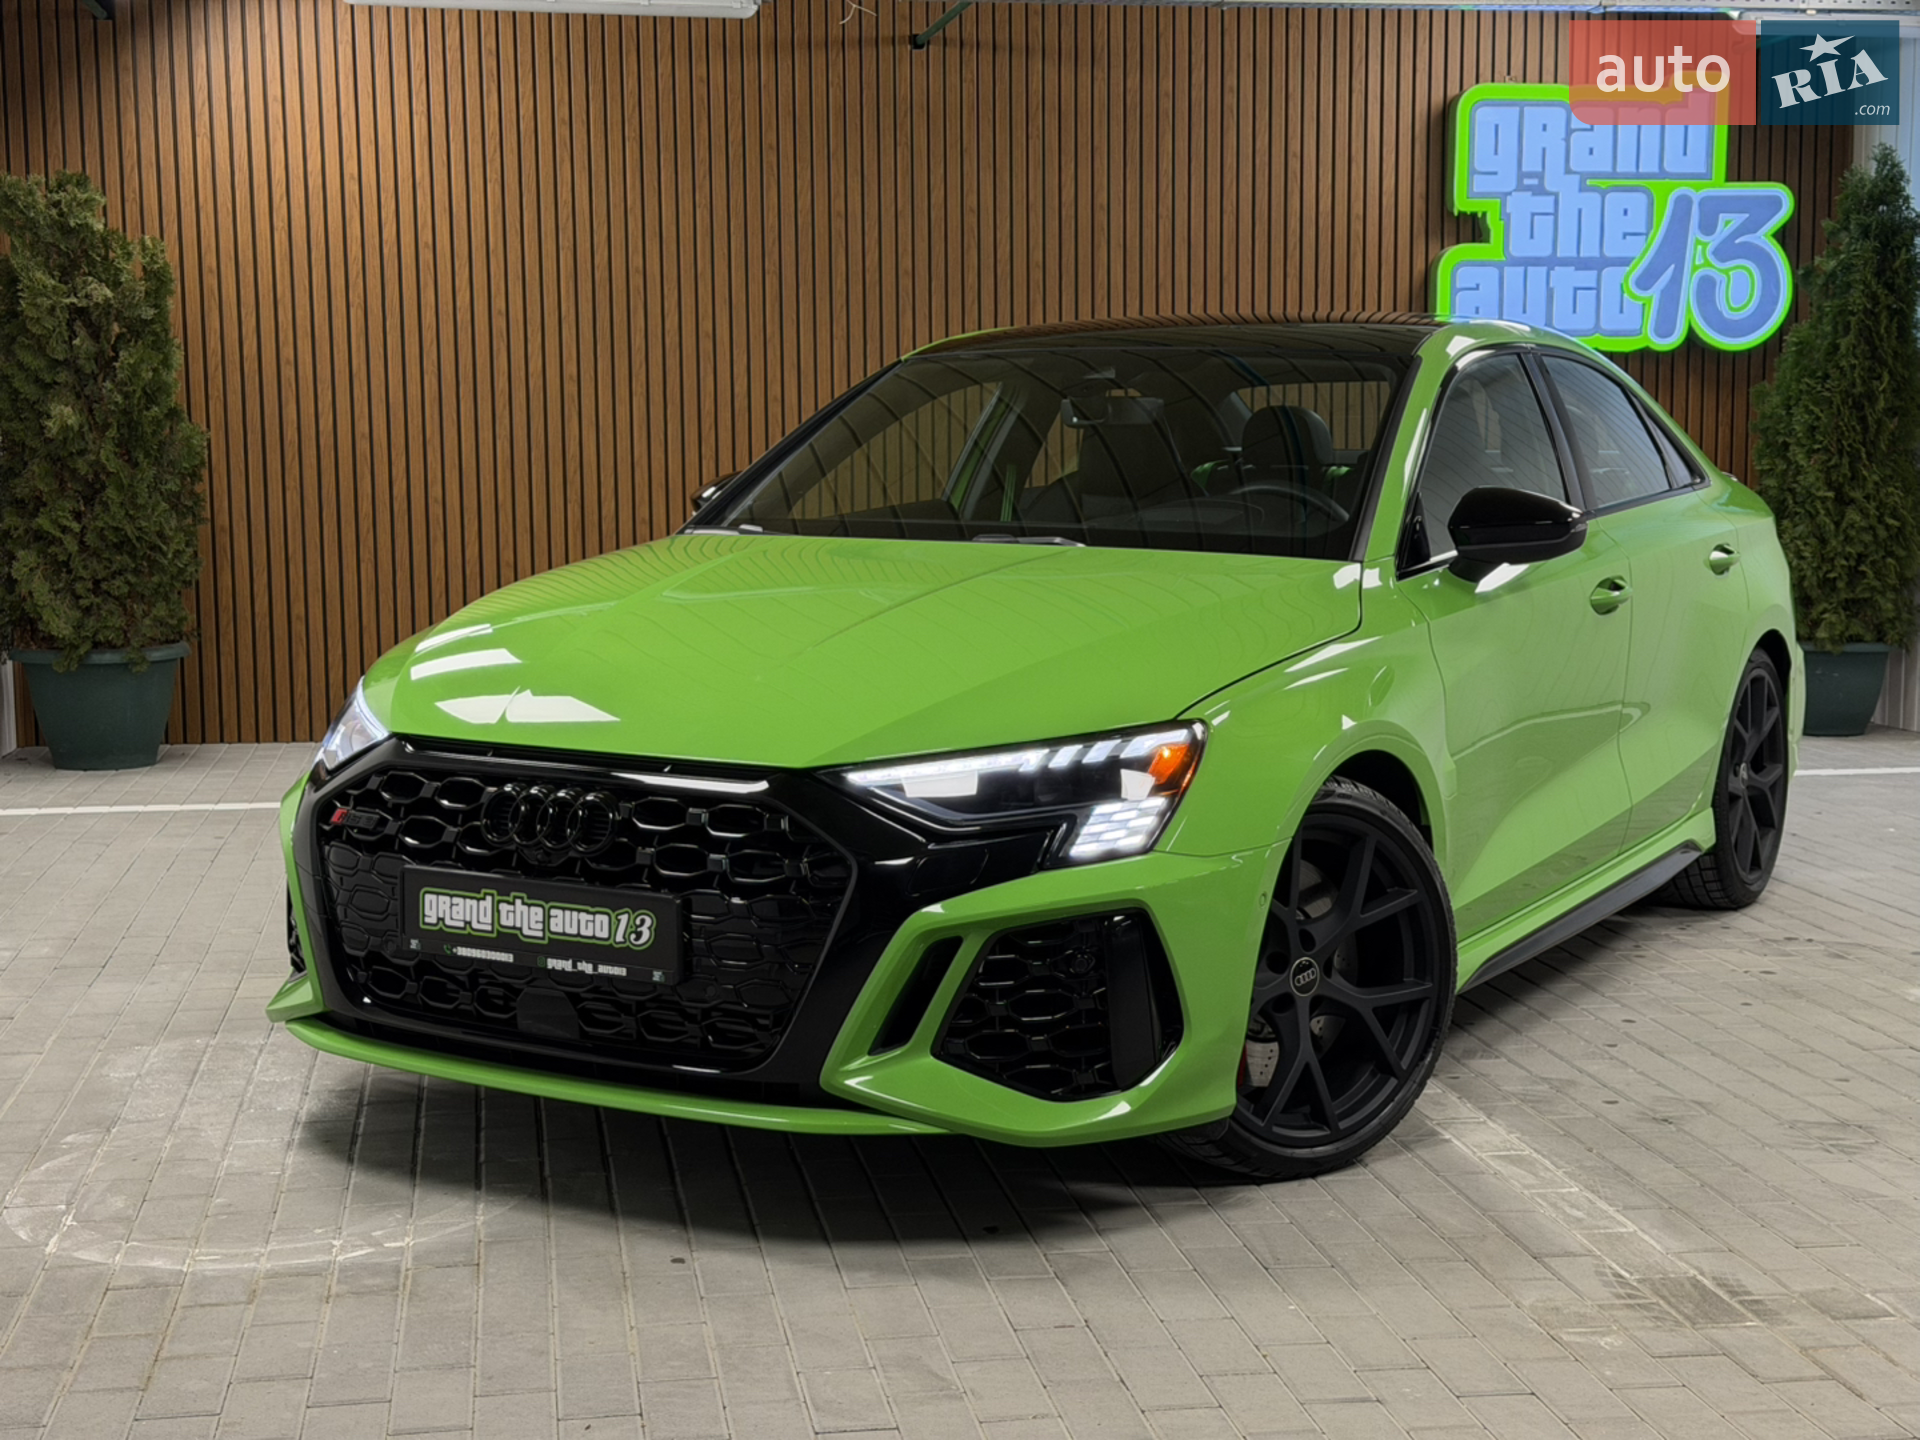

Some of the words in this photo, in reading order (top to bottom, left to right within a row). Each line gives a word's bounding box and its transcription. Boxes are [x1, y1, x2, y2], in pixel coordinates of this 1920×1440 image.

[1506, 175, 1649, 258] the
[1628, 187, 1789, 345] 13
[498, 898, 544, 938] the
[549, 907, 610, 939] auto
[614, 912, 653, 945] 13
